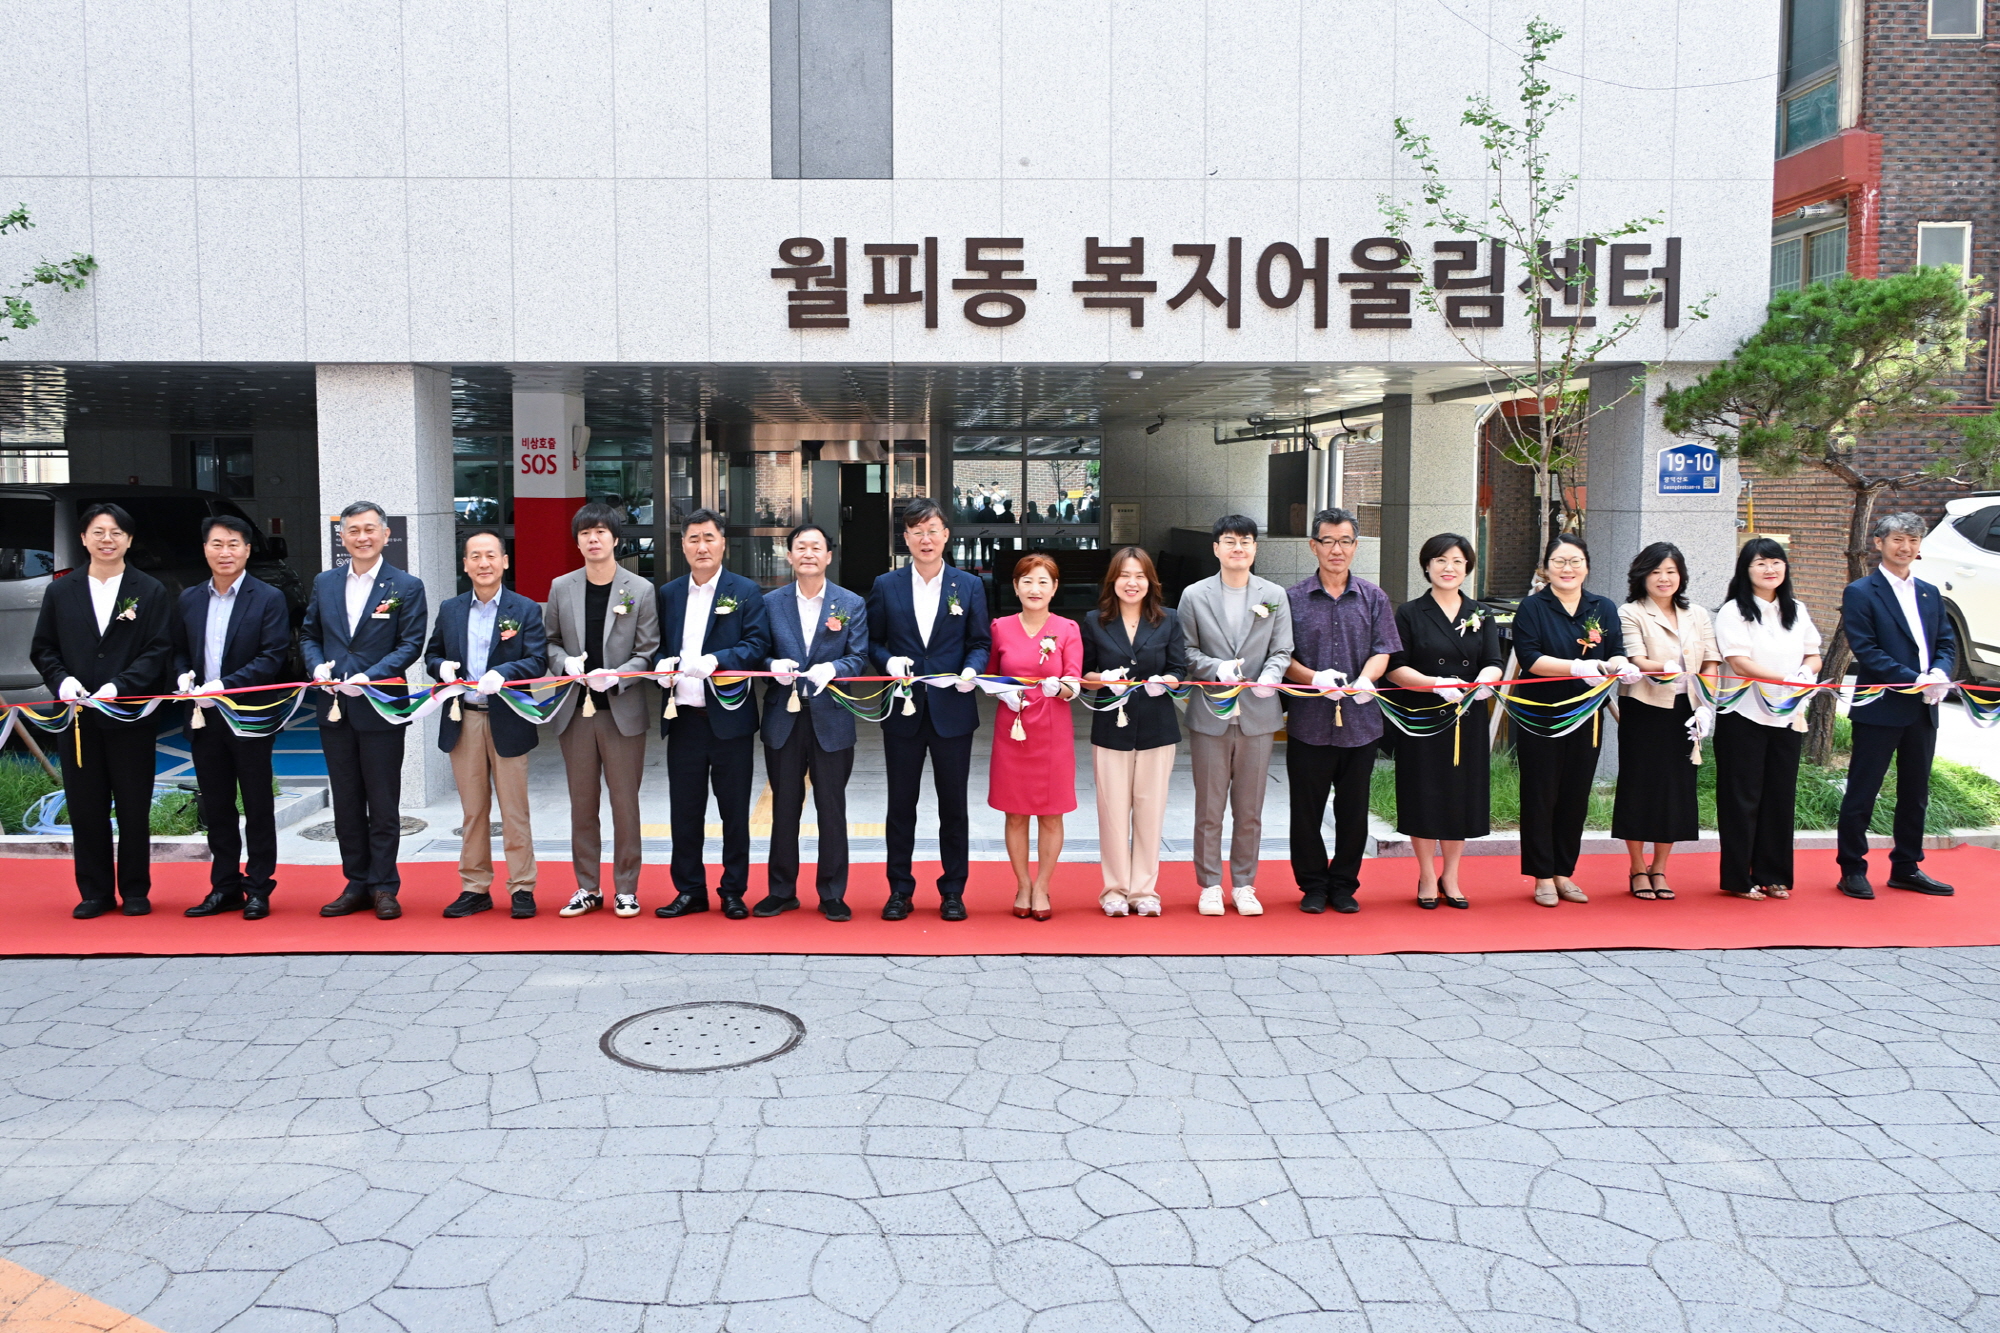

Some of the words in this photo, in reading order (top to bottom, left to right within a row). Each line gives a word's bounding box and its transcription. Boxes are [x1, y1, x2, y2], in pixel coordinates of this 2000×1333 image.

[771, 236, 1038, 329] 월피동
[1072, 235, 1682, 329] 복지어울림센터
[520, 453, 558, 475] SOS
[1666, 452, 1714, 472] 19-10
